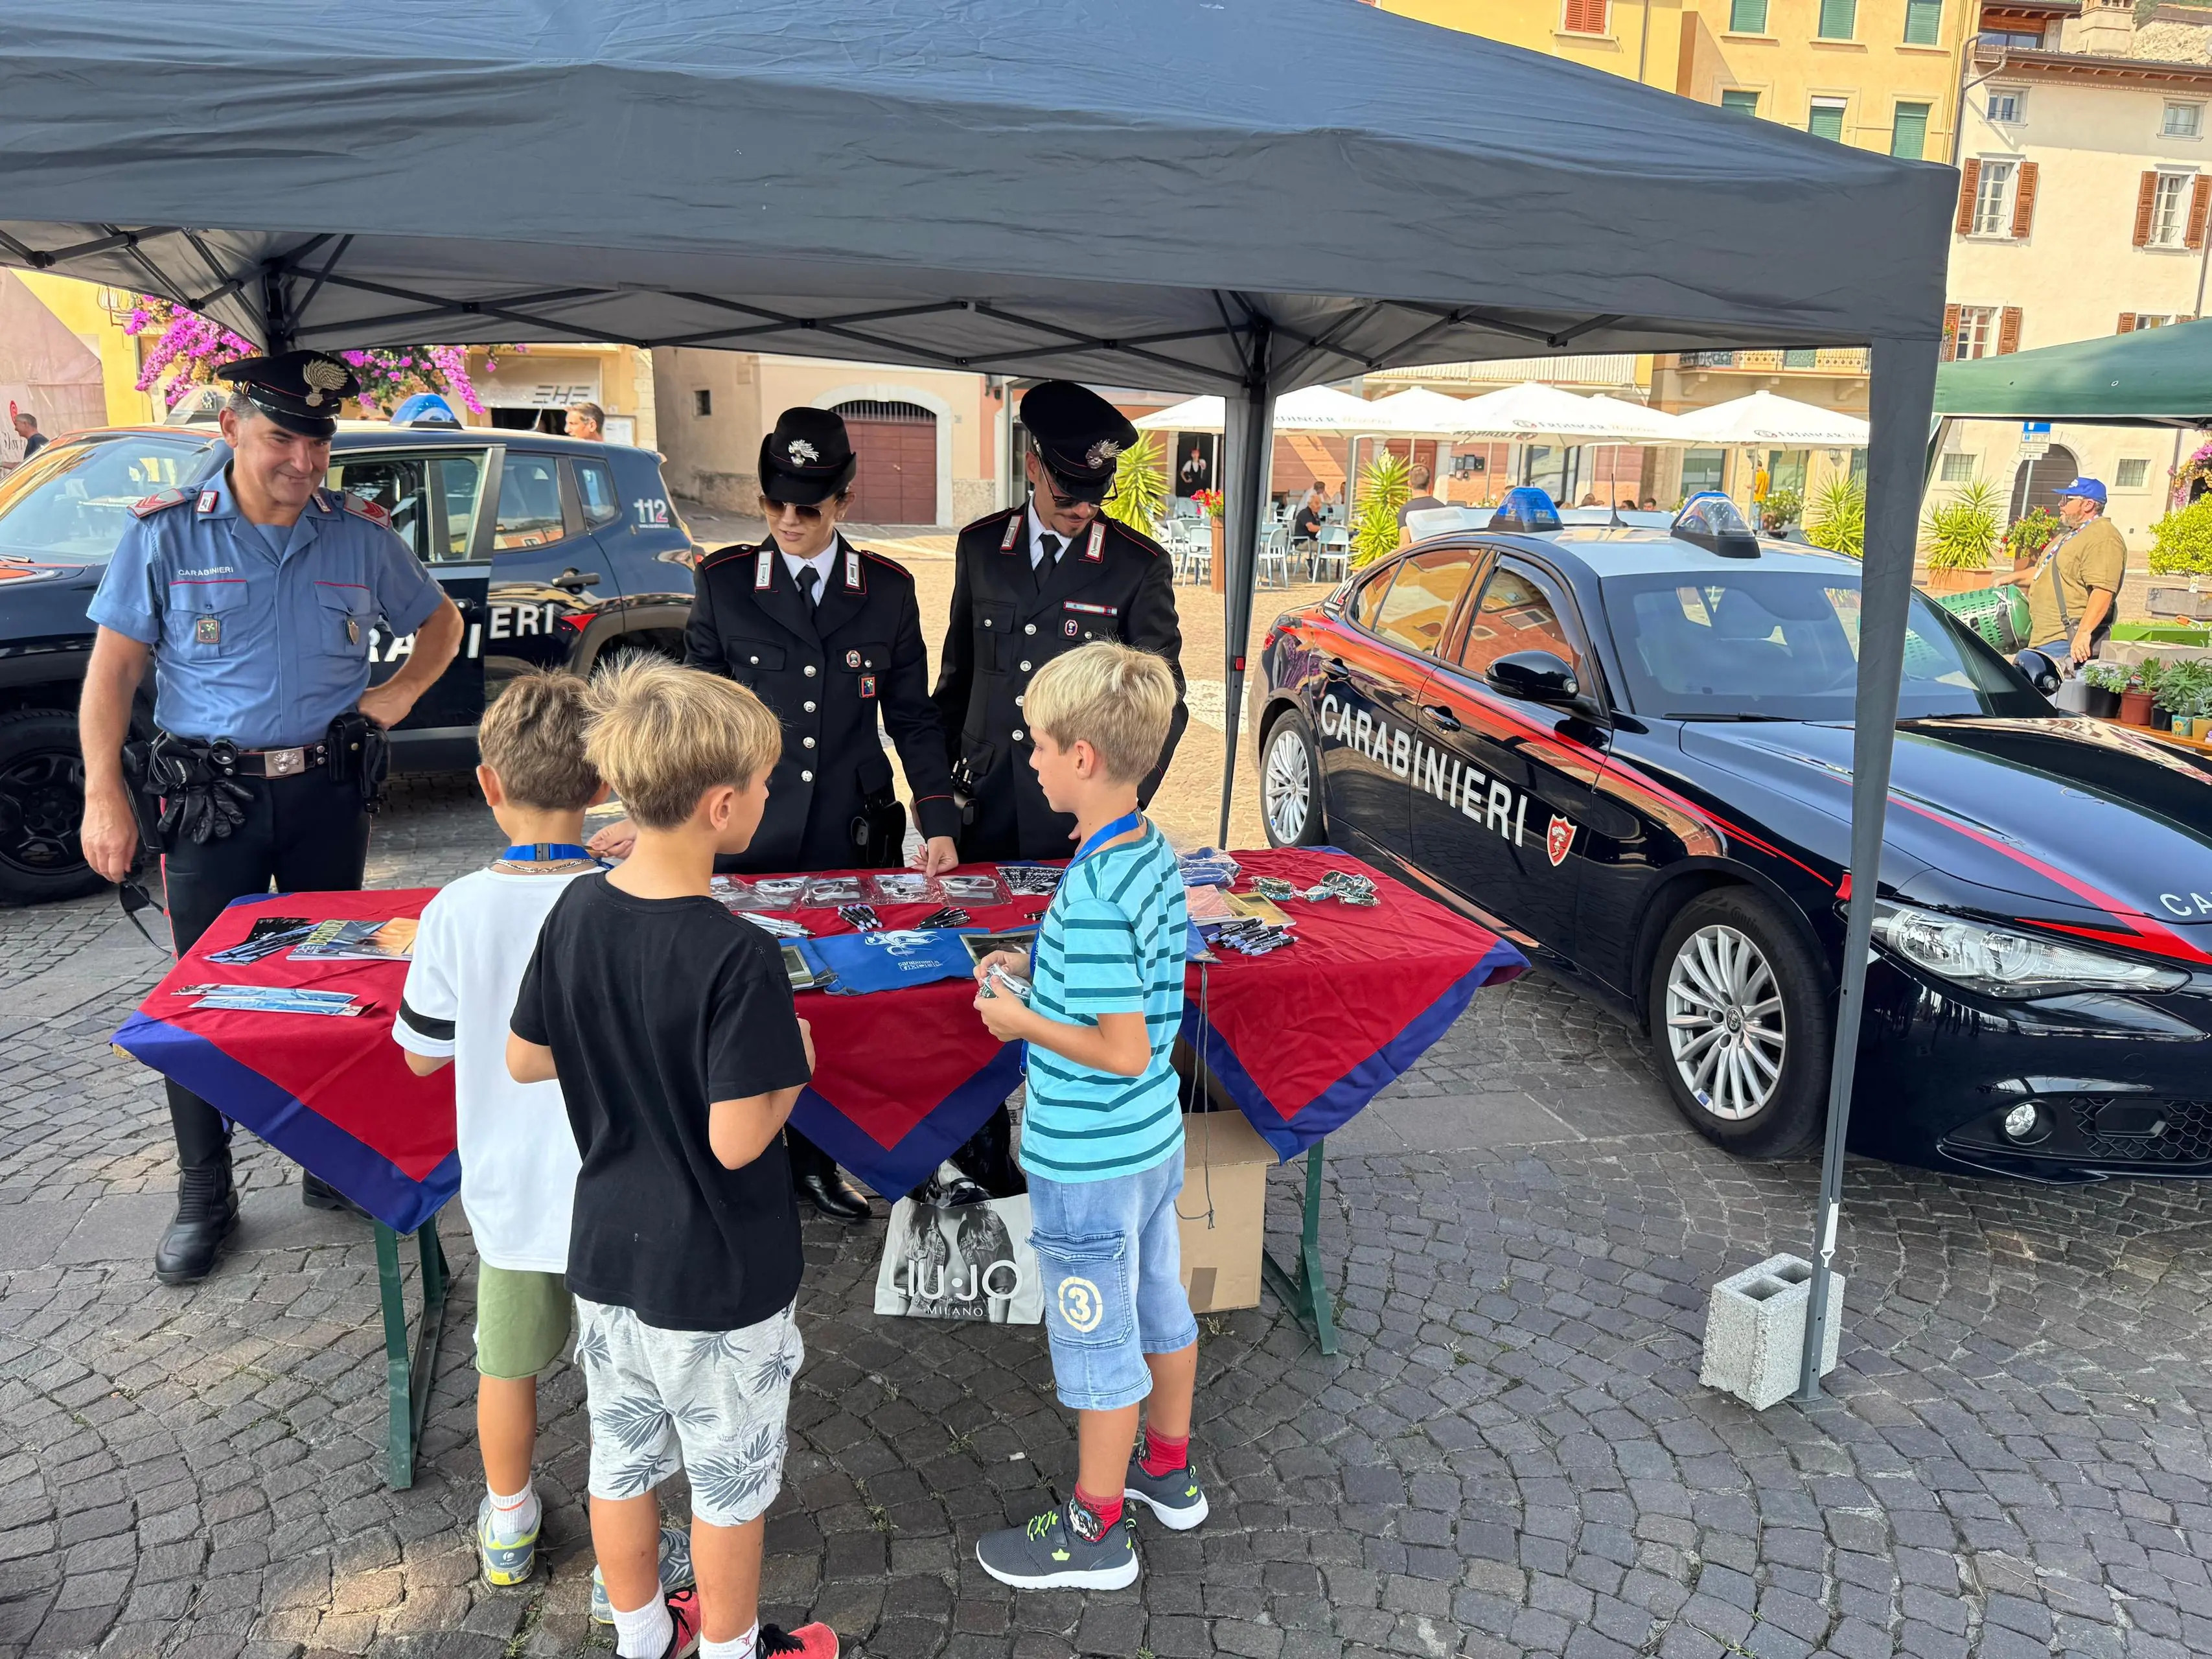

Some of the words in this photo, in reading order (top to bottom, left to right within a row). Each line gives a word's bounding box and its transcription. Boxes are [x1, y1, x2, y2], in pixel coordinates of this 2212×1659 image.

[633, 498, 669, 523] 112
[178, 566, 234, 576] CARABINIERI
[1320, 693, 1528, 848] CARABINIERI
[2160, 892, 2212, 916] CA
[925, 1305, 984, 1317] MILANO
[1068, 1287, 1091, 1321] 3
